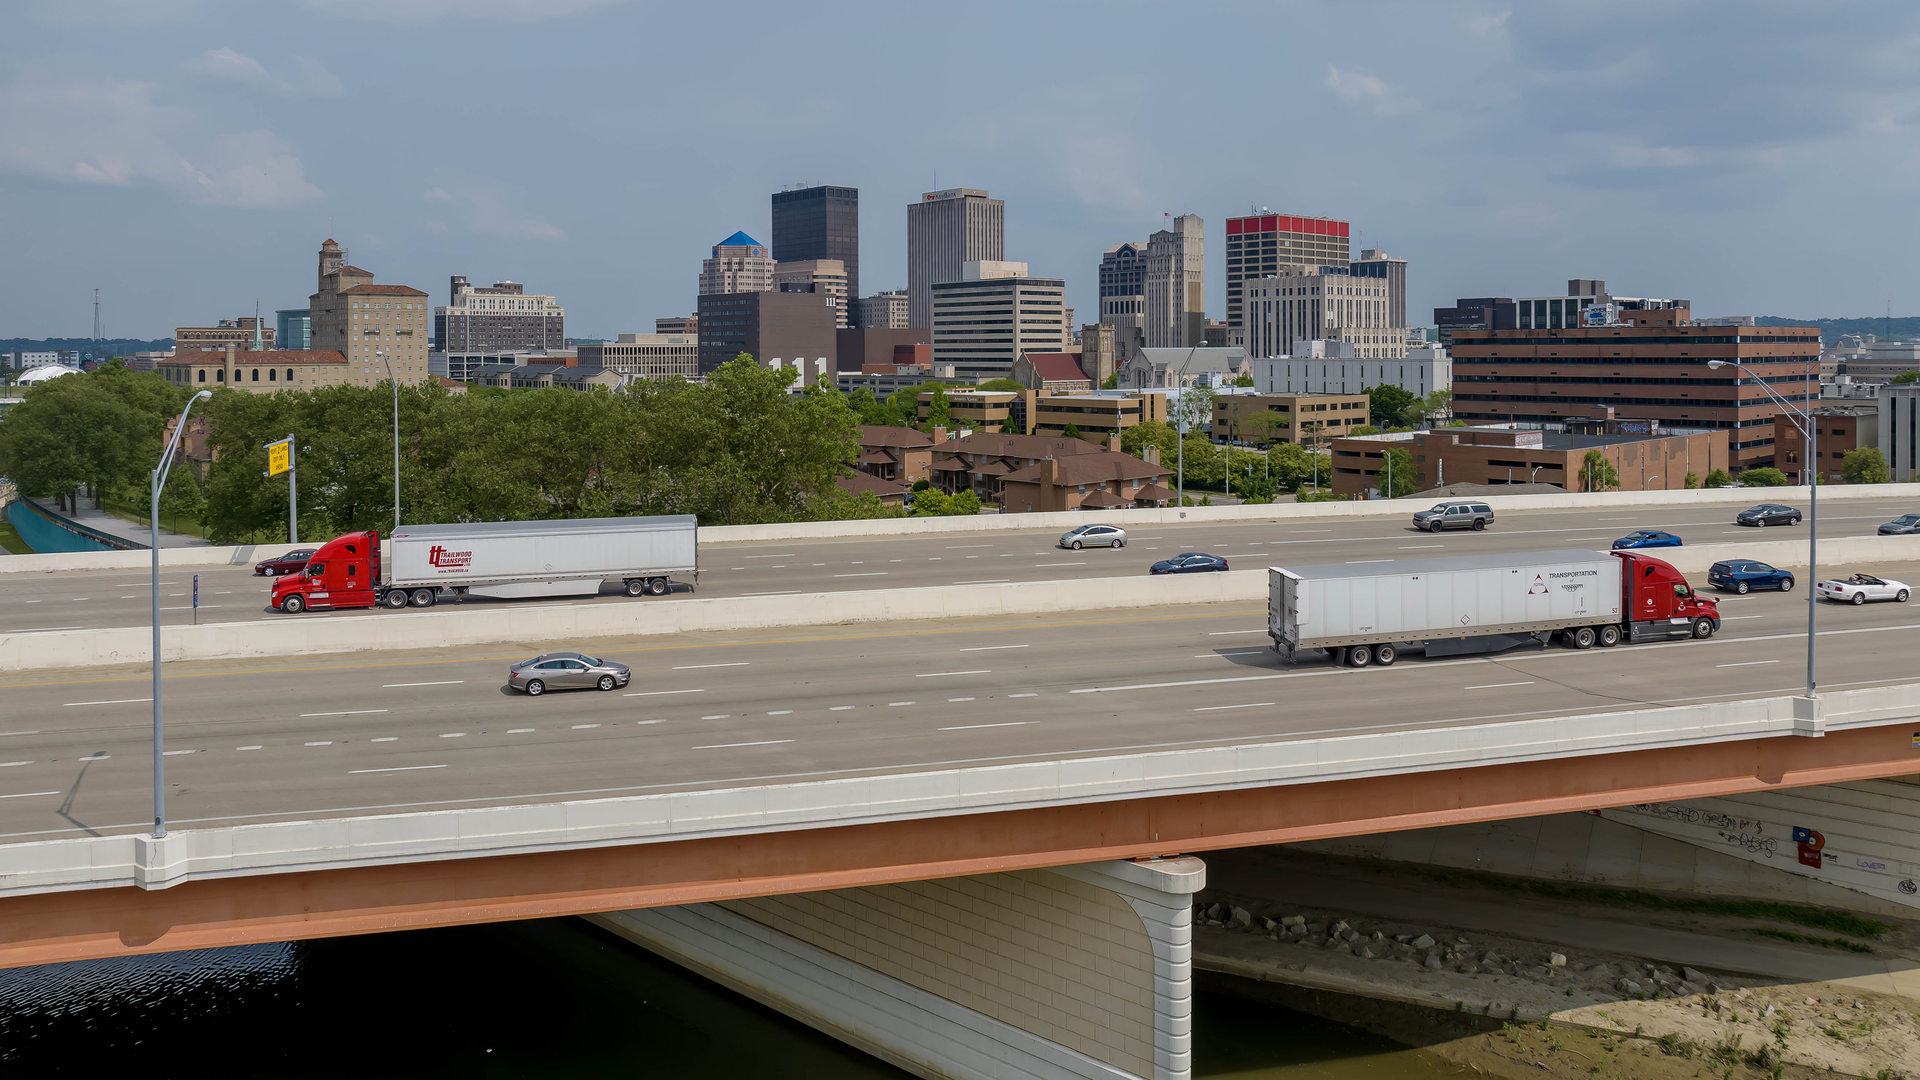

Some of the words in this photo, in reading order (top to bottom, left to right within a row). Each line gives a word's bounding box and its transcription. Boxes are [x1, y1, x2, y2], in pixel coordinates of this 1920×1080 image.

[935, 192, 957, 200] KeyBank
[826, 297, 836, 307] 111
[1549, 570, 1598, 578] TRANSPORTATION
